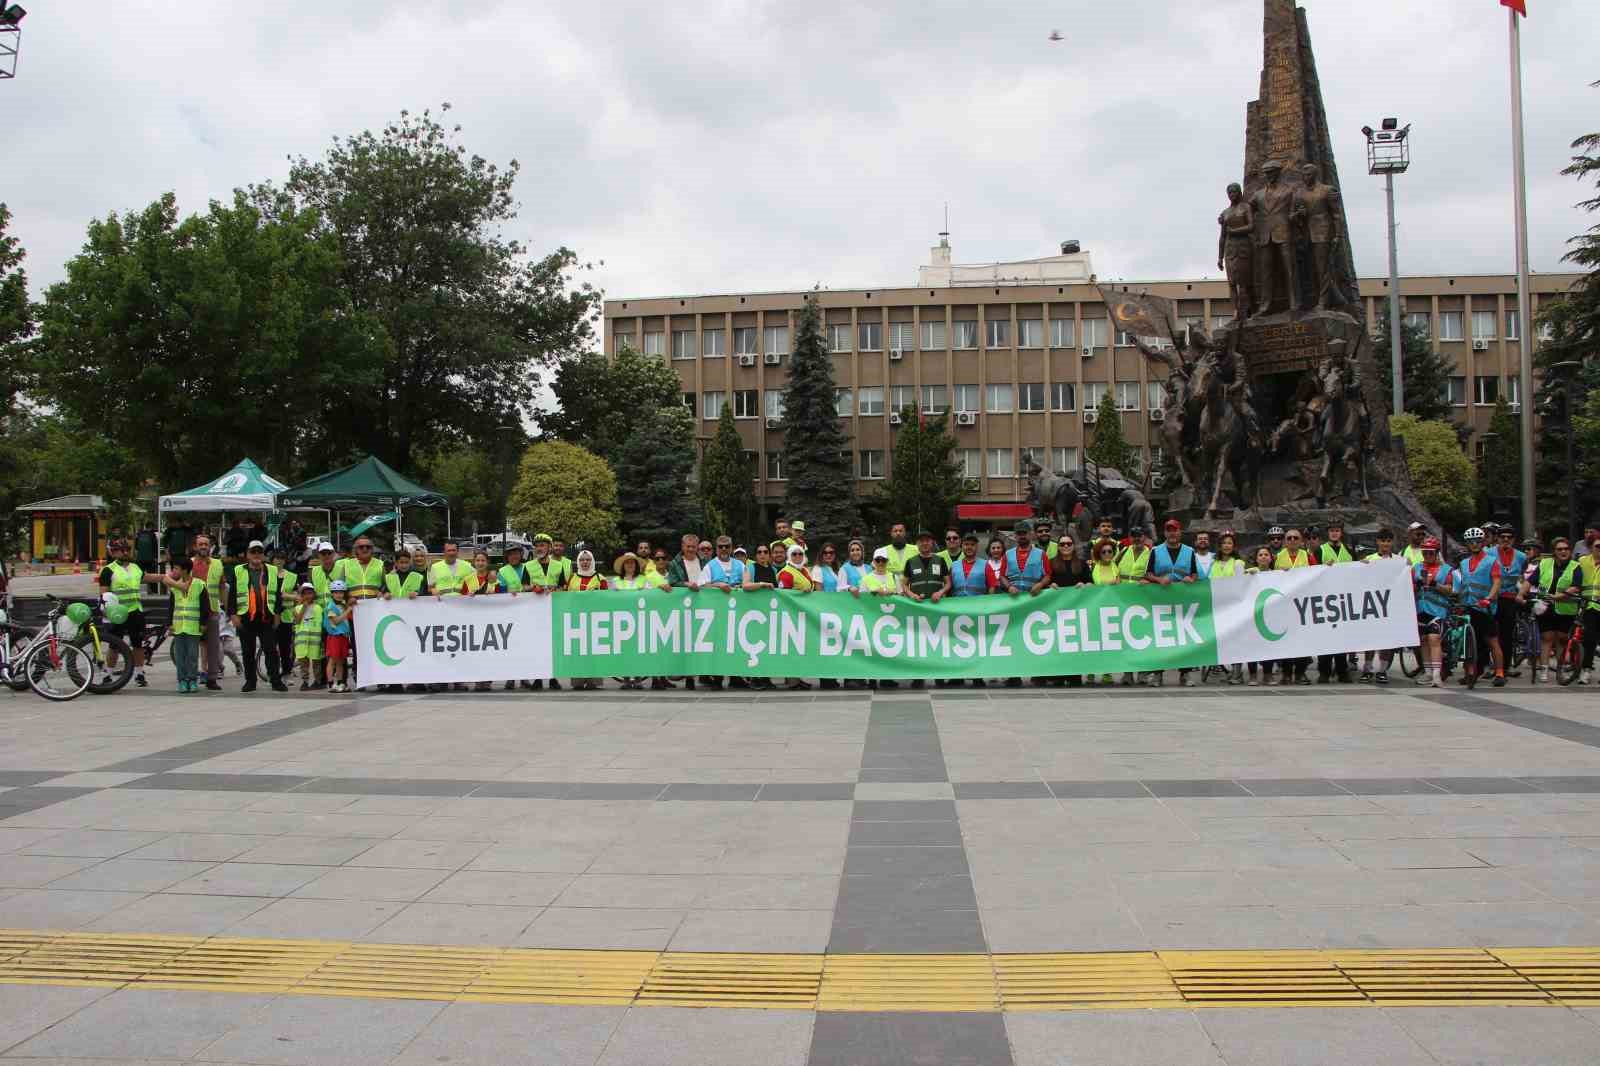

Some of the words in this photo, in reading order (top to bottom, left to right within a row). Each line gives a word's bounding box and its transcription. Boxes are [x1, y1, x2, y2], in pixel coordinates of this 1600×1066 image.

[563, 597, 715, 656] HEPİMİZ
[727, 597, 806, 668] İÇİN
[820, 603, 1011, 658] BAĞIMSIZ
[1023, 604, 1204, 655] GELECEK
